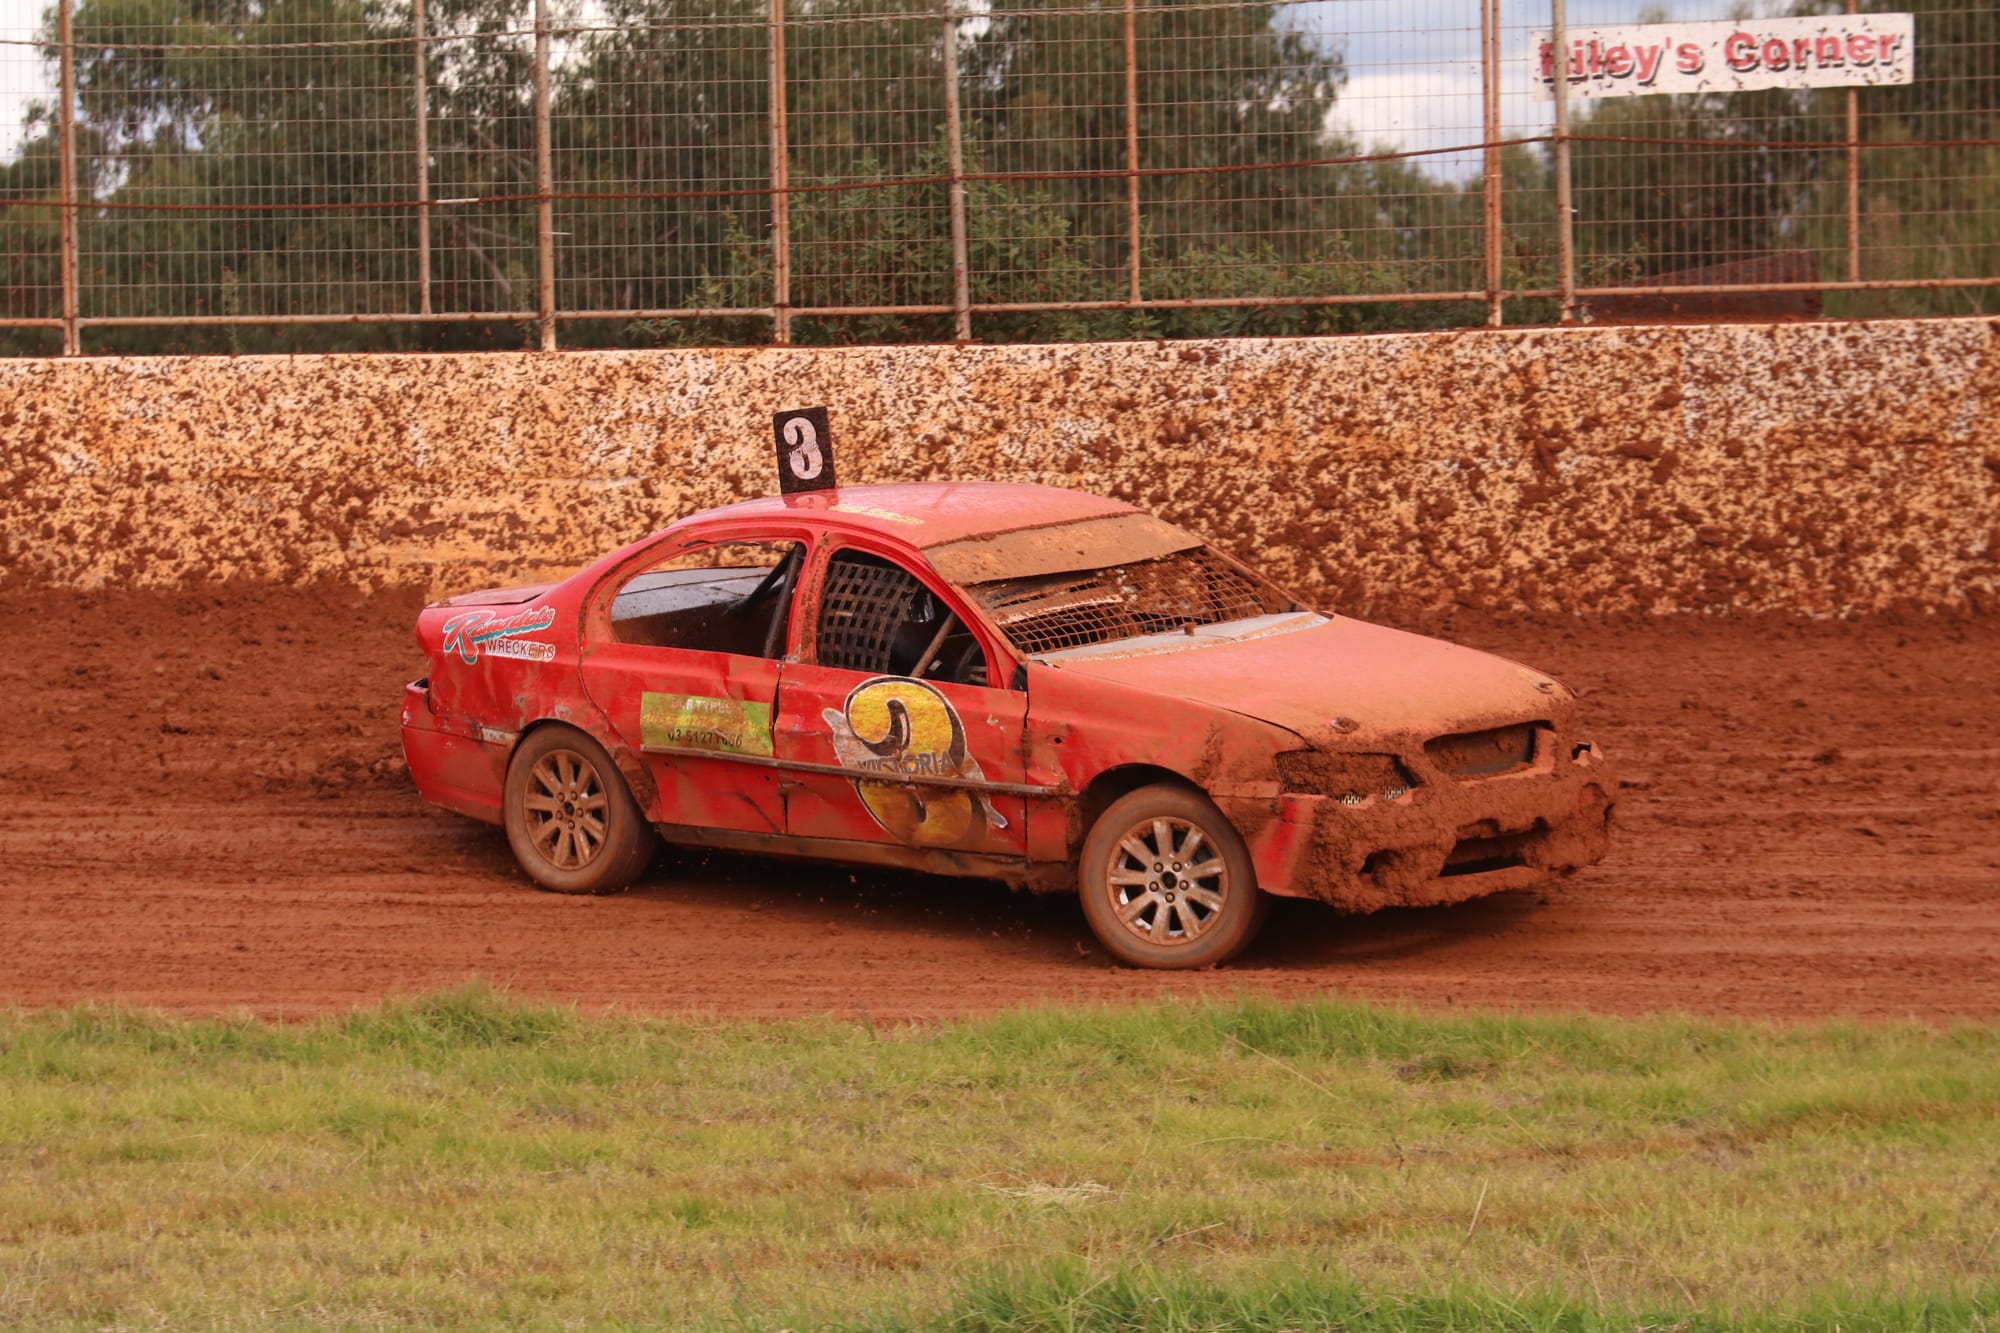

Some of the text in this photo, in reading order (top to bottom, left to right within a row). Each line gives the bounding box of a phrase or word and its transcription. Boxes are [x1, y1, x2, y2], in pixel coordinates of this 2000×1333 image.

[1540, 31, 1902, 85] Riley's Corner
[783, 417, 823, 480] 3
[487, 640, 555, 660] WRECKERS
[857, 751, 957, 777] VICTORIA
